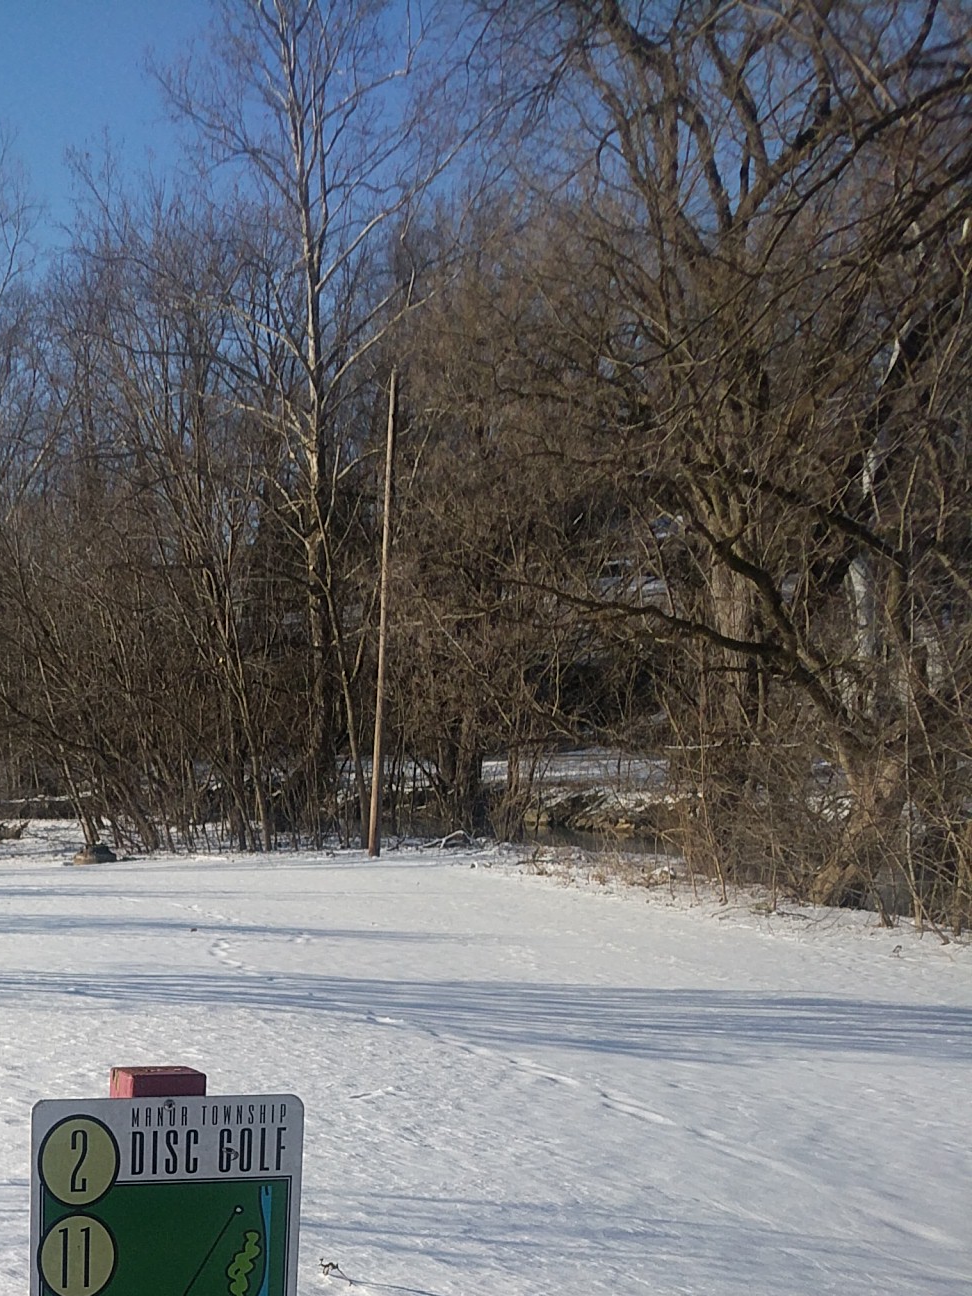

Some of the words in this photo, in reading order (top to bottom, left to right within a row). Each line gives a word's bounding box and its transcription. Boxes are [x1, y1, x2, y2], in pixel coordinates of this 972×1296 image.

[132, 1106, 188, 1127] MANOR
[202, 1104, 287, 1125] TOWNSHIP
[70, 1130, 88, 1192] 2
[131, 1129, 199, 1175] DISC
[219, 1127, 287, 1172] GOLF
[58, 1227, 90, 1288] 11
